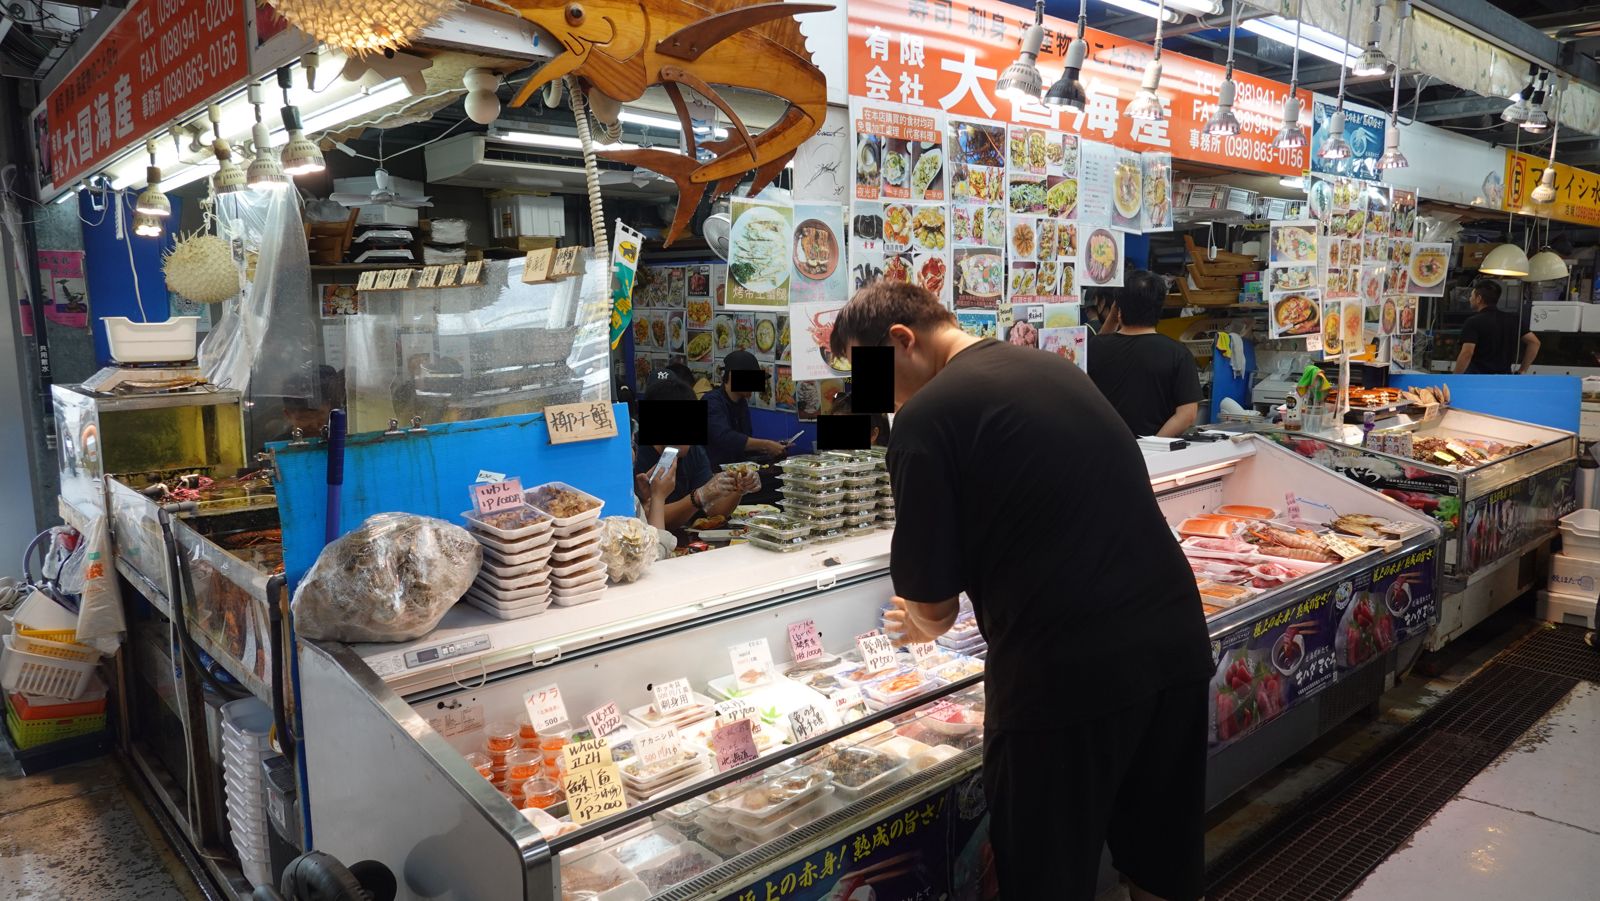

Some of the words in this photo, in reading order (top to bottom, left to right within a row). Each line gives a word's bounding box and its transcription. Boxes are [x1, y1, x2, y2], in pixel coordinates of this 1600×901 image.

[137, 13, 155, 43] TEL
[865, 26, 925, 69] 有限
[140, 45, 159, 83] FAX
[164, 31, 237, 107] (098)863-0156
[865, 65, 924, 106] 会社
[64, 74, 135, 174] 大国海産
[1190, 128, 1221, 153] 事務所
[1225, 136, 1303, 168] (098)863-0156
[551, 403, 613, 432] 椰子蟹
[528, 687, 558, 705] イクラ
[661, 695, 689, 710] 刺身用
[569, 738, 607, 757] Whale
[853, 797, 944, 863] 熟成の旨さ!
